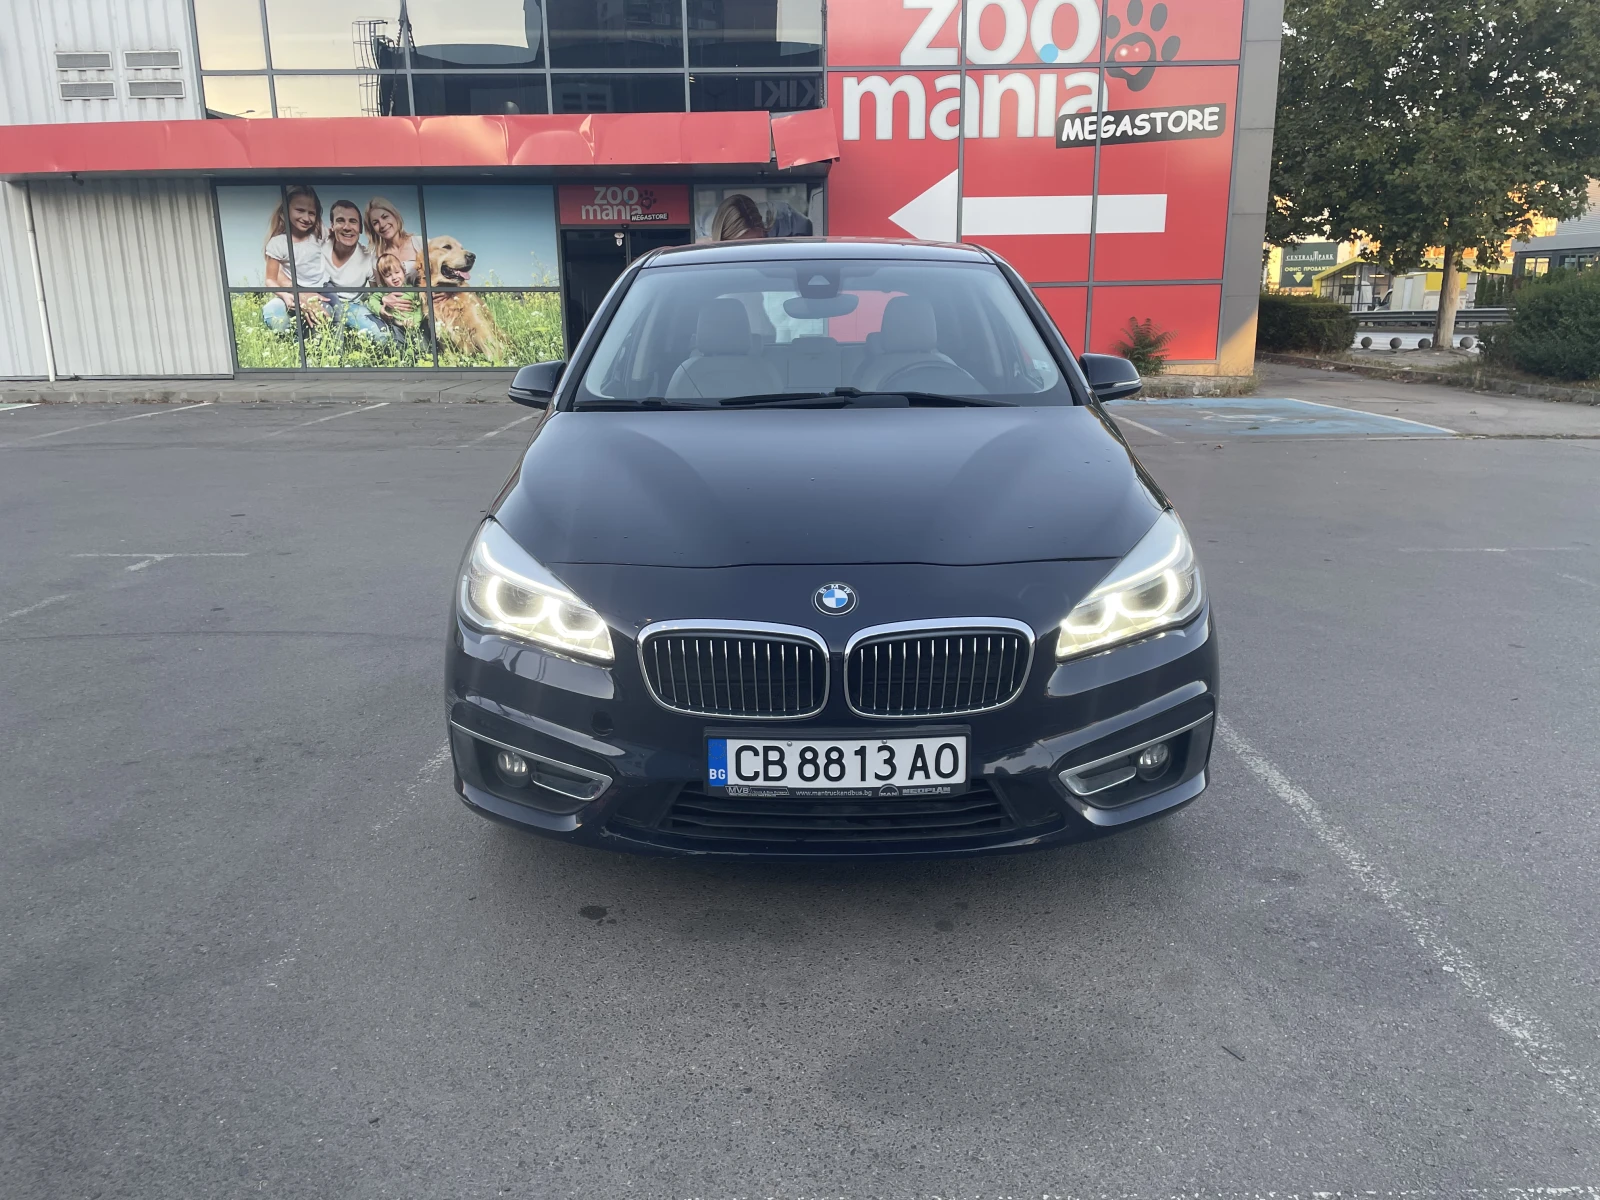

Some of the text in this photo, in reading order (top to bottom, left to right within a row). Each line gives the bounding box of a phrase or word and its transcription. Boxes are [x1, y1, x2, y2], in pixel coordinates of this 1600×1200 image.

[842, 71, 1109, 141] mania
[1061, 106, 1220, 142] MEGASTORE
[581, 204, 643, 220] mania
[631, 213, 668, 221] MEGASTORE
[709, 768, 727, 780] BG
[735, 743, 960, 783] CB 8813 AO
